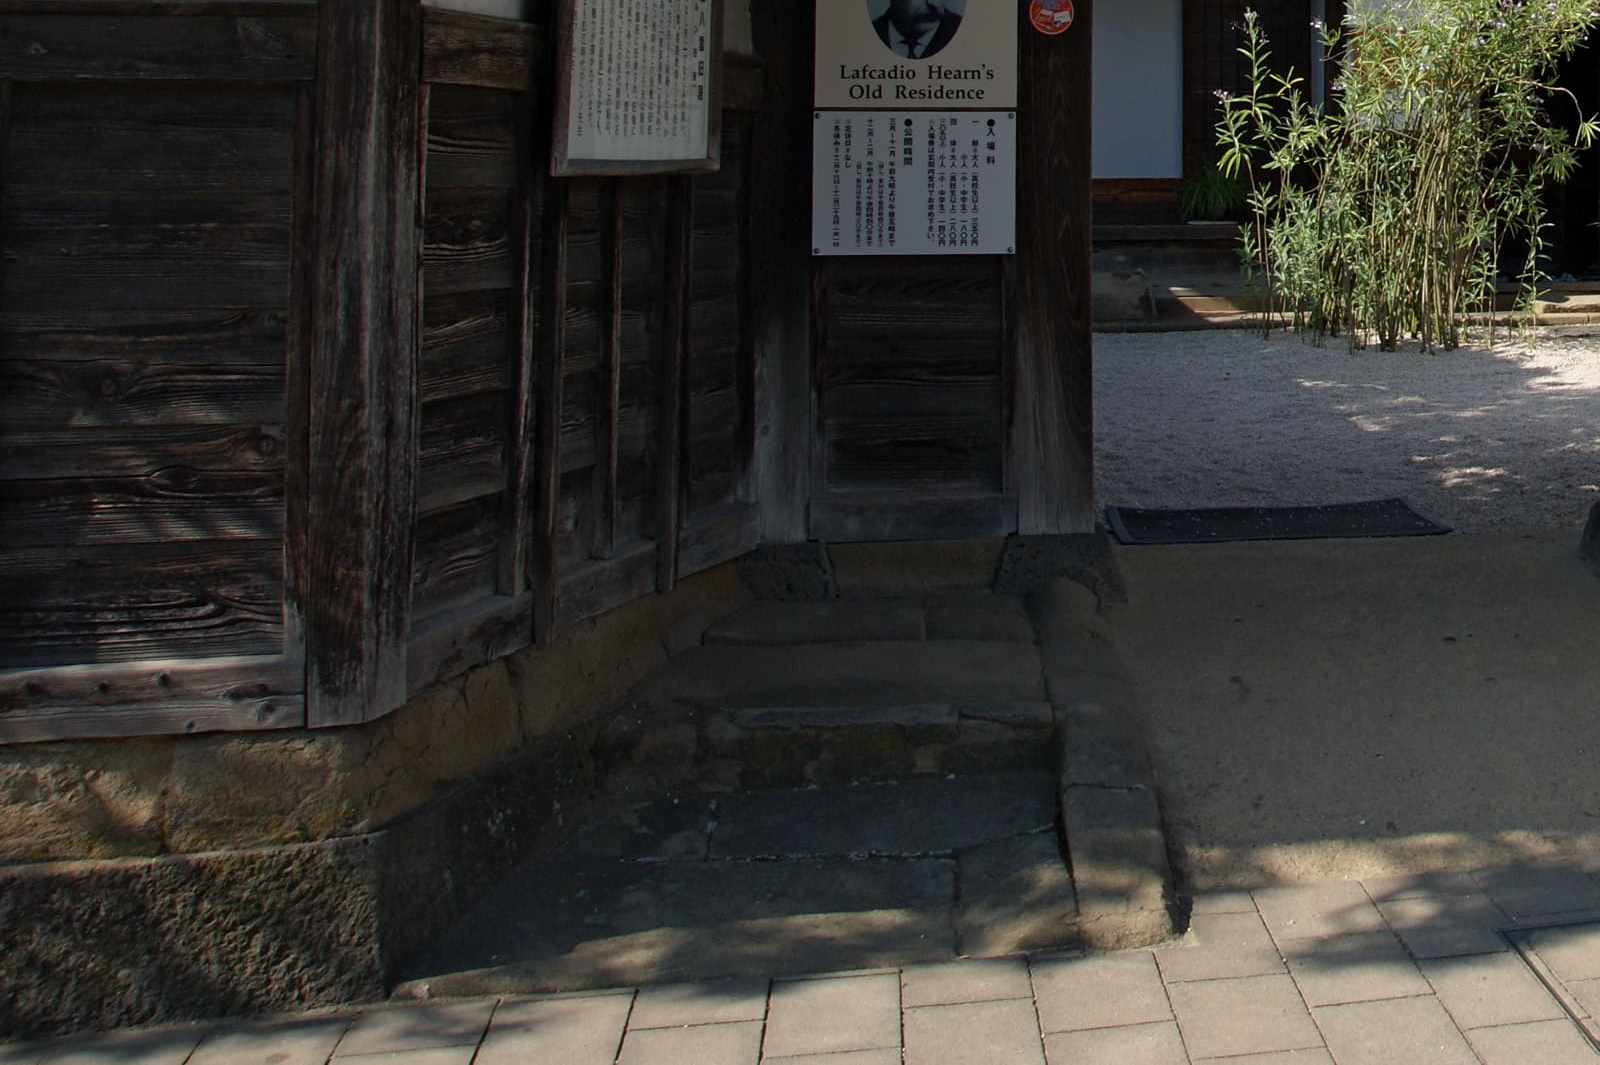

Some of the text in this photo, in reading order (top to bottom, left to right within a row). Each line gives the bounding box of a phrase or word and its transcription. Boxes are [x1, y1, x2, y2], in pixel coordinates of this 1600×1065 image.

[840, 63, 995, 81] Lafcadio Hearn's
[848, 83, 986, 101] Old Residence
